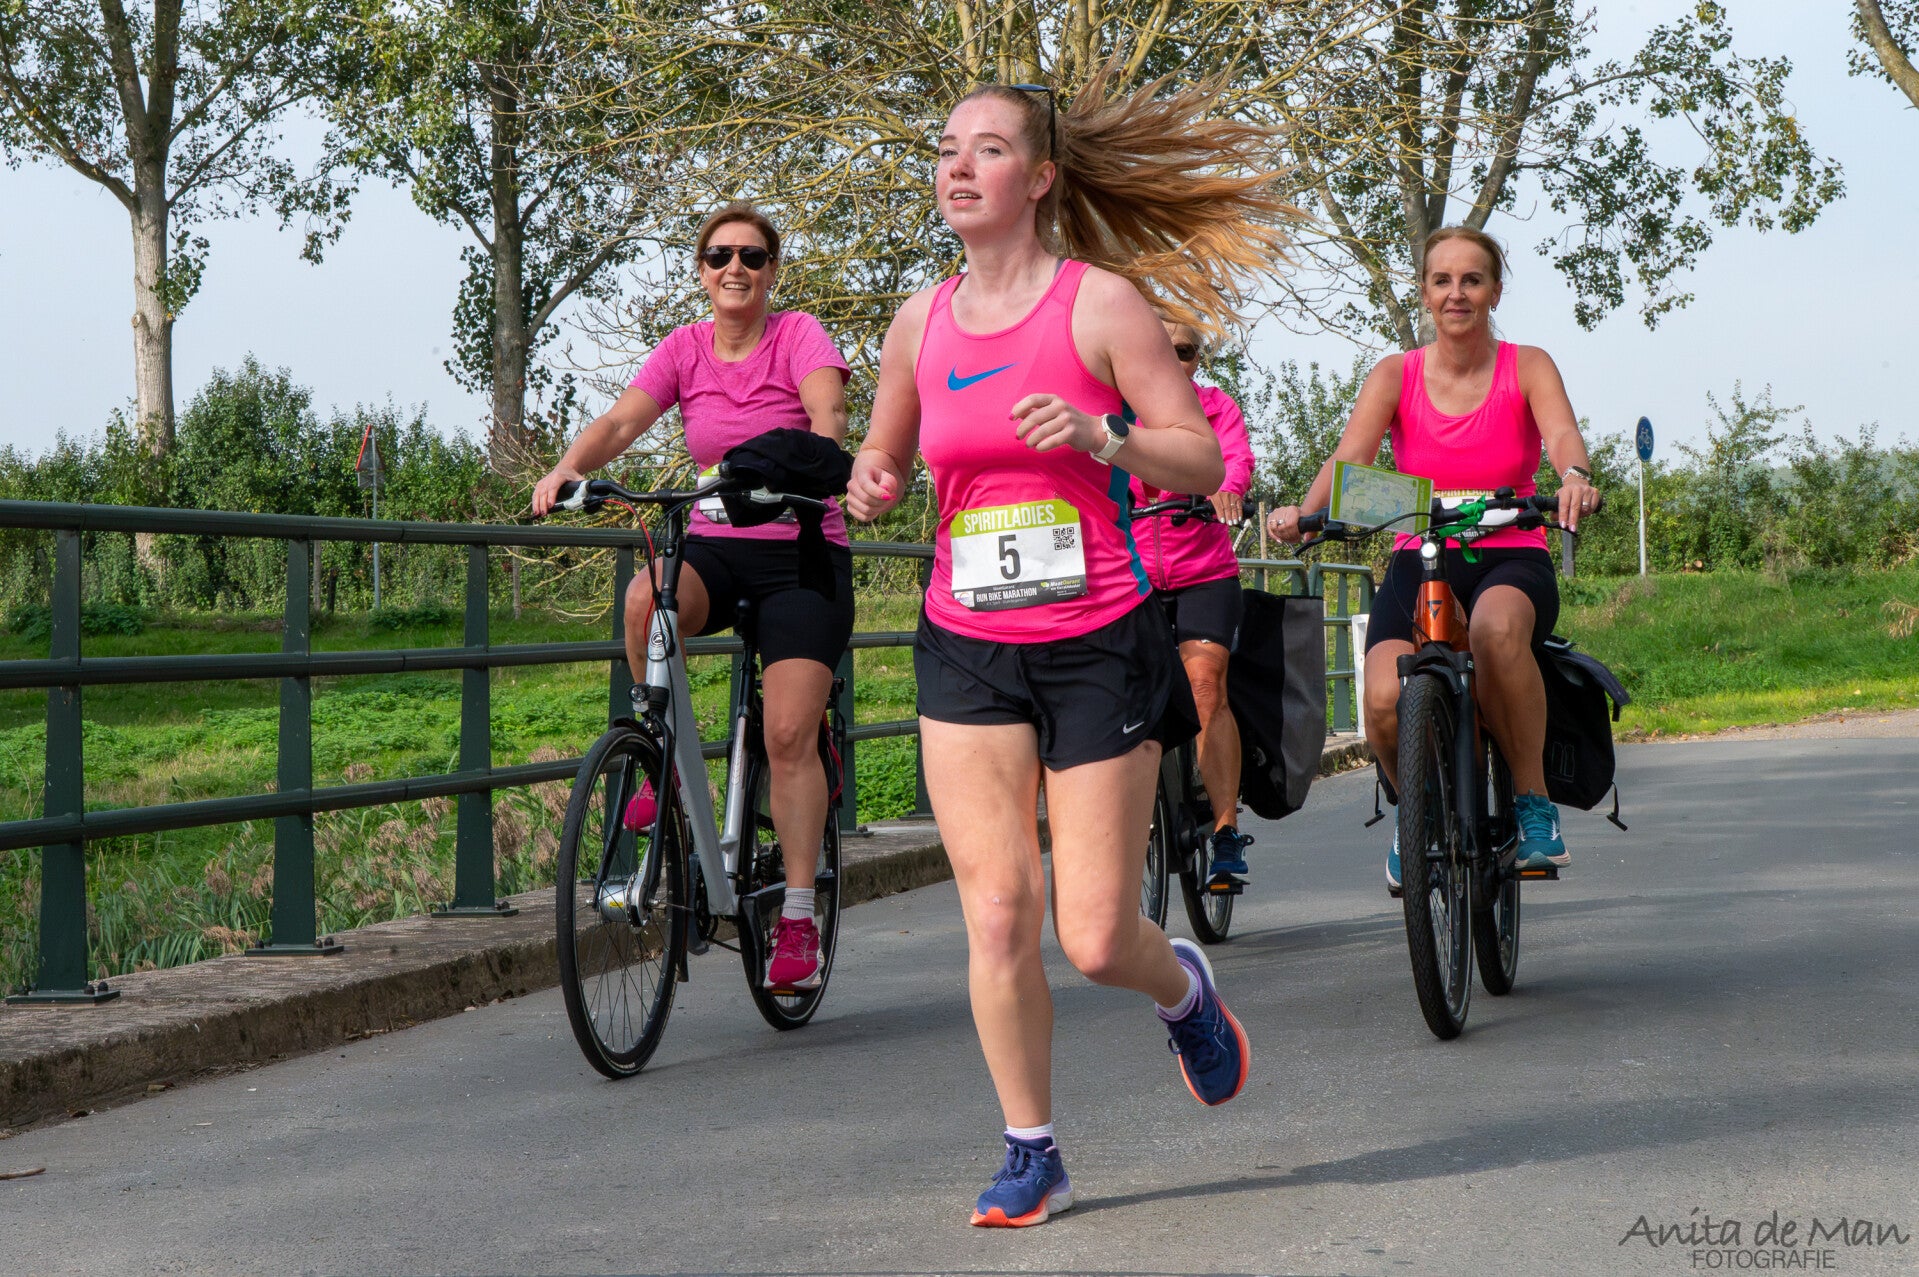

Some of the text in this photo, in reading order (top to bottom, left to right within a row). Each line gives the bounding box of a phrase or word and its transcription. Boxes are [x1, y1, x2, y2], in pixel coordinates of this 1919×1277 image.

[963, 504, 1056, 534] SPIRITLADIES
[998, 534, 1021, 580] 5
[976, 592, 989, 603] RUN
[988, 590, 1003, 602] BIKE
[1002, 587, 1038, 600] MARATHON
